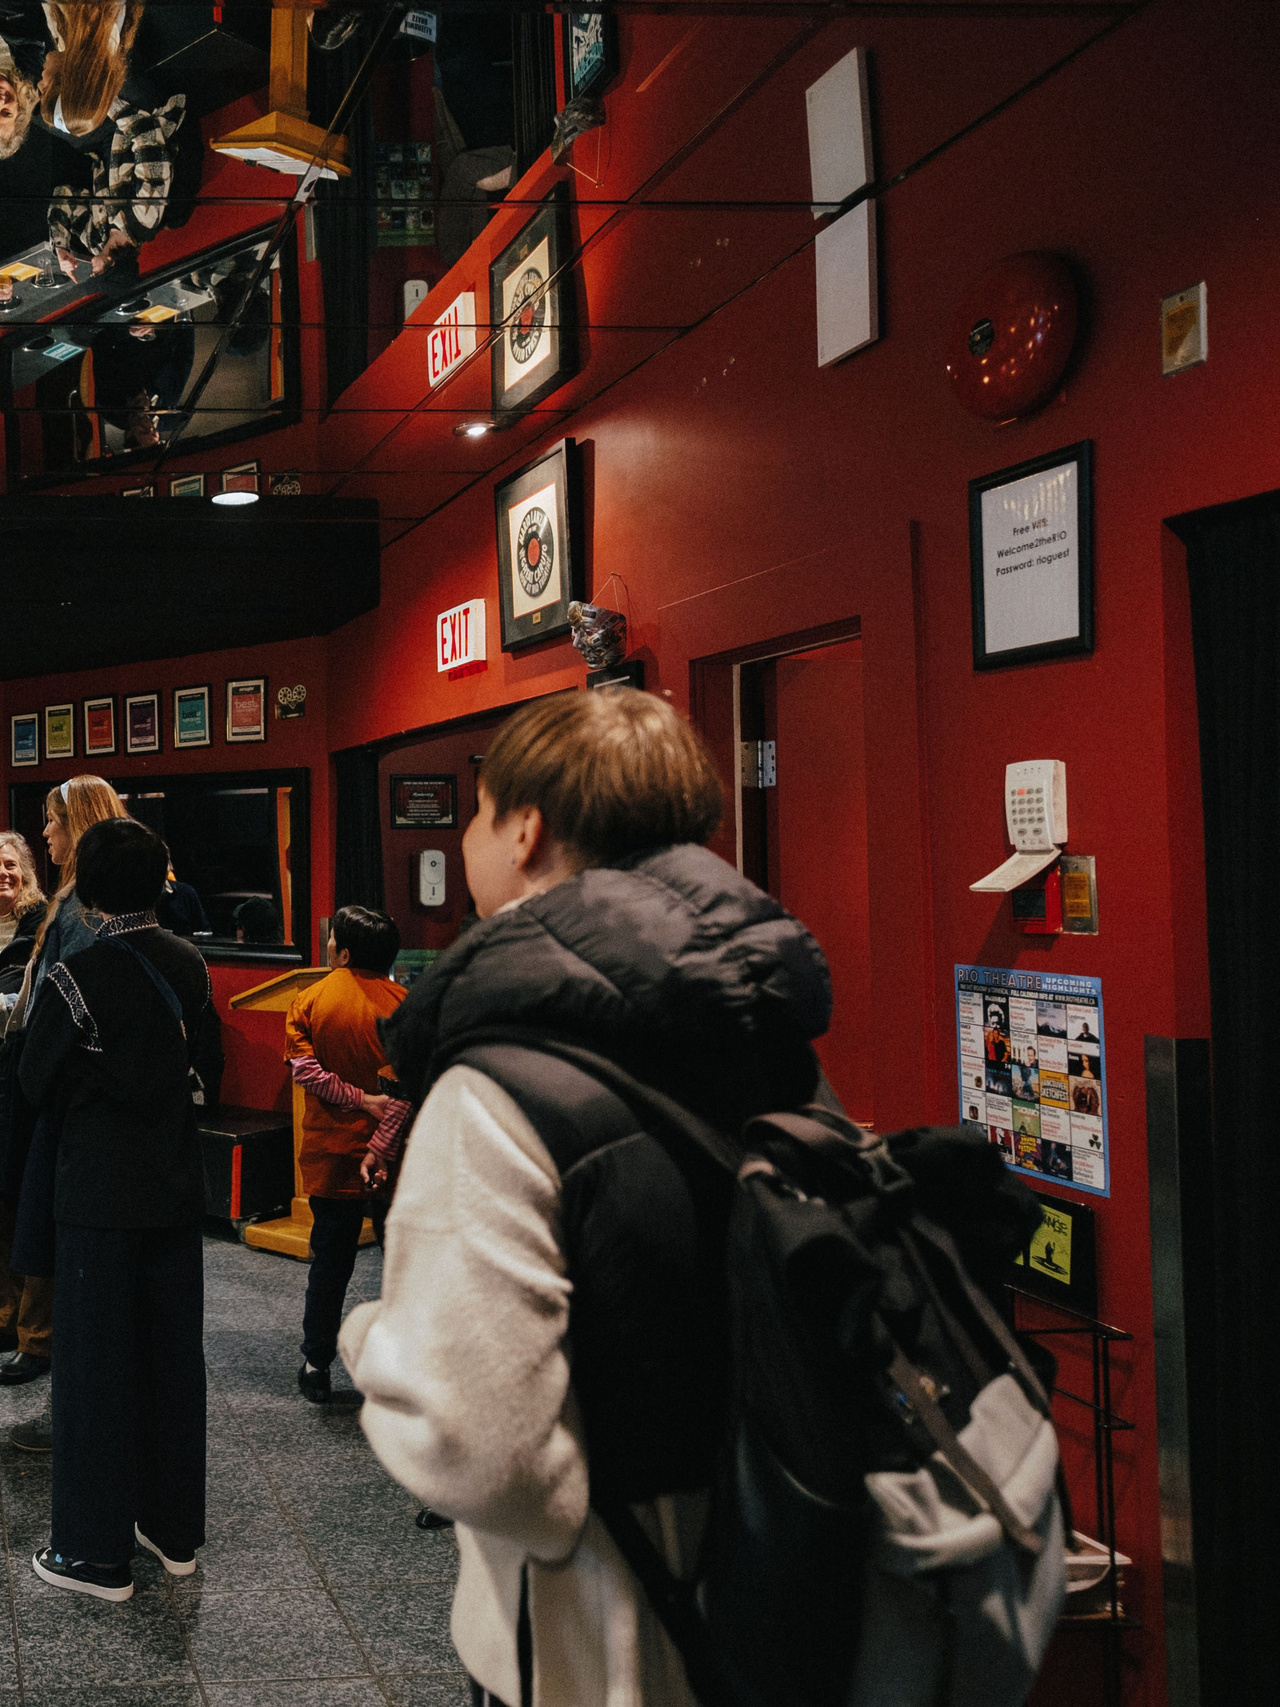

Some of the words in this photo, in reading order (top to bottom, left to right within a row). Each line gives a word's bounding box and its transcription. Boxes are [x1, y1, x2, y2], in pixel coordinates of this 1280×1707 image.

[1012, 524, 1030, 537] Free
[996, 530, 1067, 559] Welcome2theRIO
[995, 559, 1035, 577] Password:
[1036, 548, 1070, 566] rioguest
[440, 607, 470, 666] EXIT
[958, 968, 979, 982] RIO
[983, 971, 1042, 990] THEATRE
[1045, 977, 1092, 988] UPCOMING
[1042, 984, 1097, 995] HIGHLIGHTS
